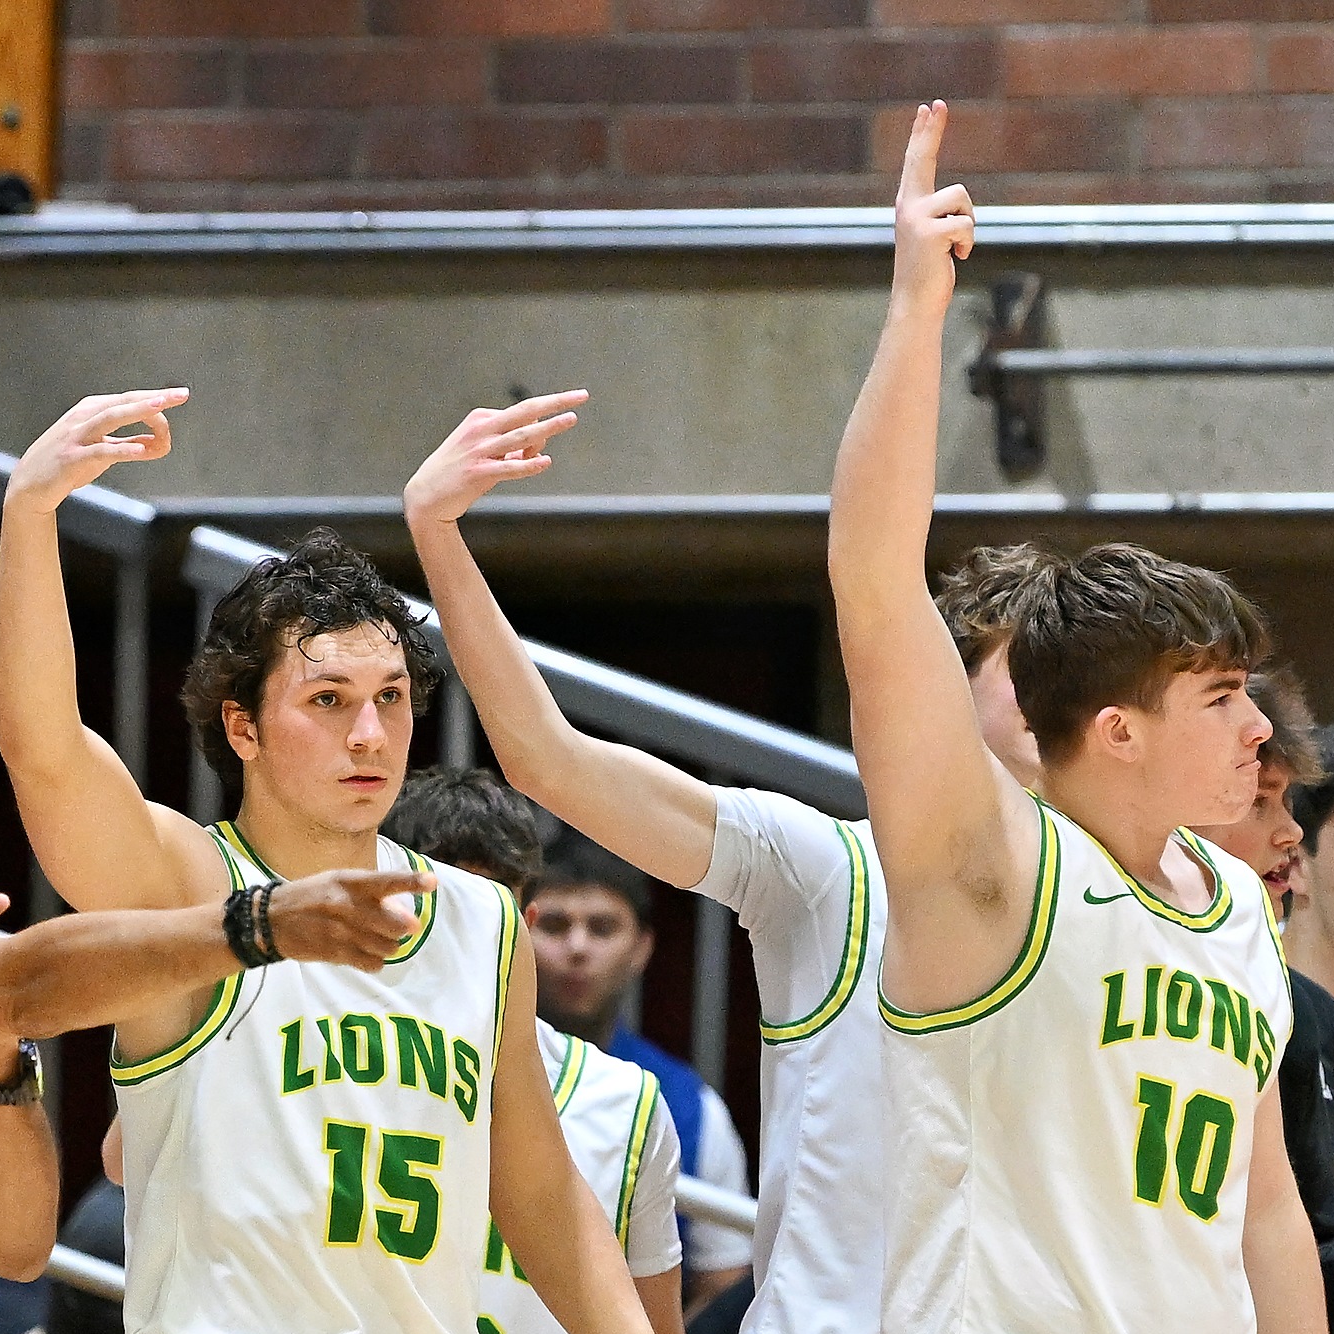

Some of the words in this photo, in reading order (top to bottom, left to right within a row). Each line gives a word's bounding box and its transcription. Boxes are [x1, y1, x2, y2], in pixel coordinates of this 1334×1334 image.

[278, 1011, 481, 1126] LIONS
[1098, 964, 1277, 1094] LIONS
[322, 1117, 445, 1265] 15
[1133, 1072, 1238, 1225] 10
